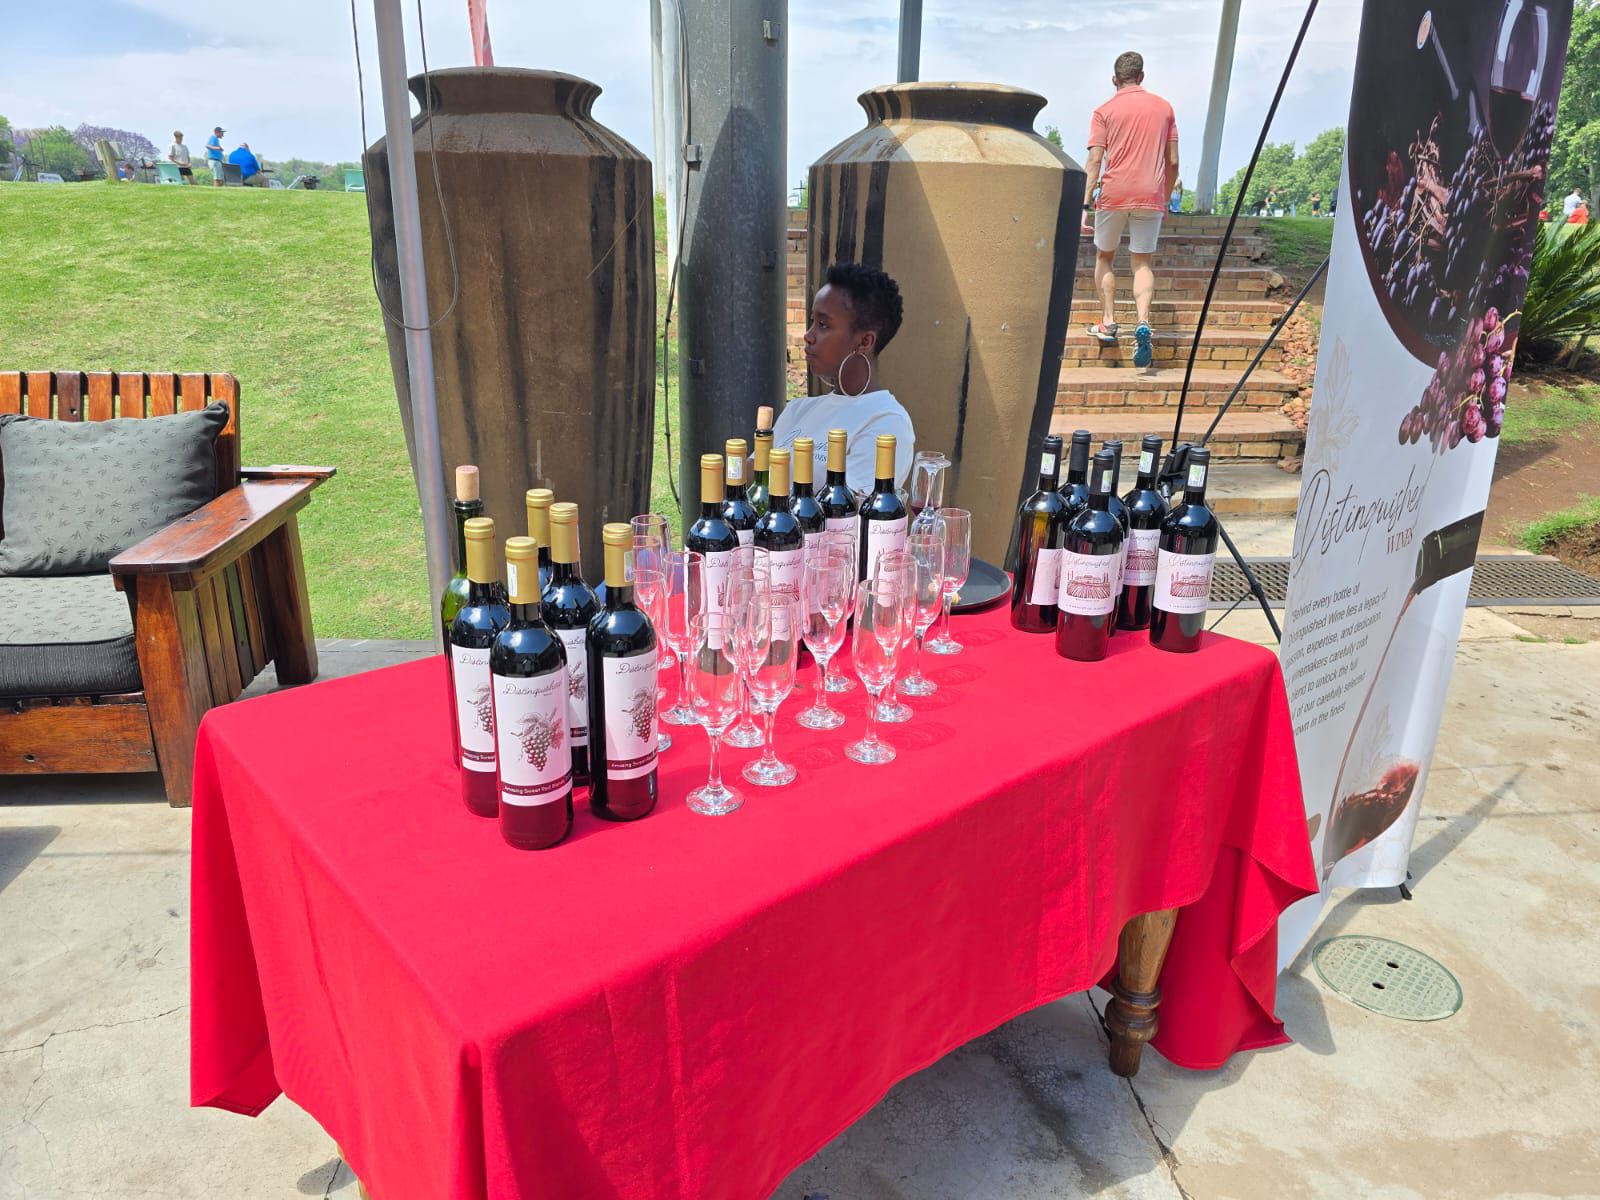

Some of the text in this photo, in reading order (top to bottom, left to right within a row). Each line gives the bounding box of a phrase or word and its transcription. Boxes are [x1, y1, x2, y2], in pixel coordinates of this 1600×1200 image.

[1312, 594, 1332, 608] every
[1332, 586, 1352, 603] bottle
[1353, 581, 1360, 595] of
[1328, 609, 1345, 624] Wine
[1306, 632, 1339, 654] expertise,
[1340, 623, 1354, 639] and
[1329, 641, 1356, 662] carefully
[1307, 681, 1315, 692] to
[1315, 669, 1337, 689] unlock
[1304, 700, 1315, 713] our
[1316, 686, 1342, 706] carefully
[504, 786, 524, 795] Amazing
